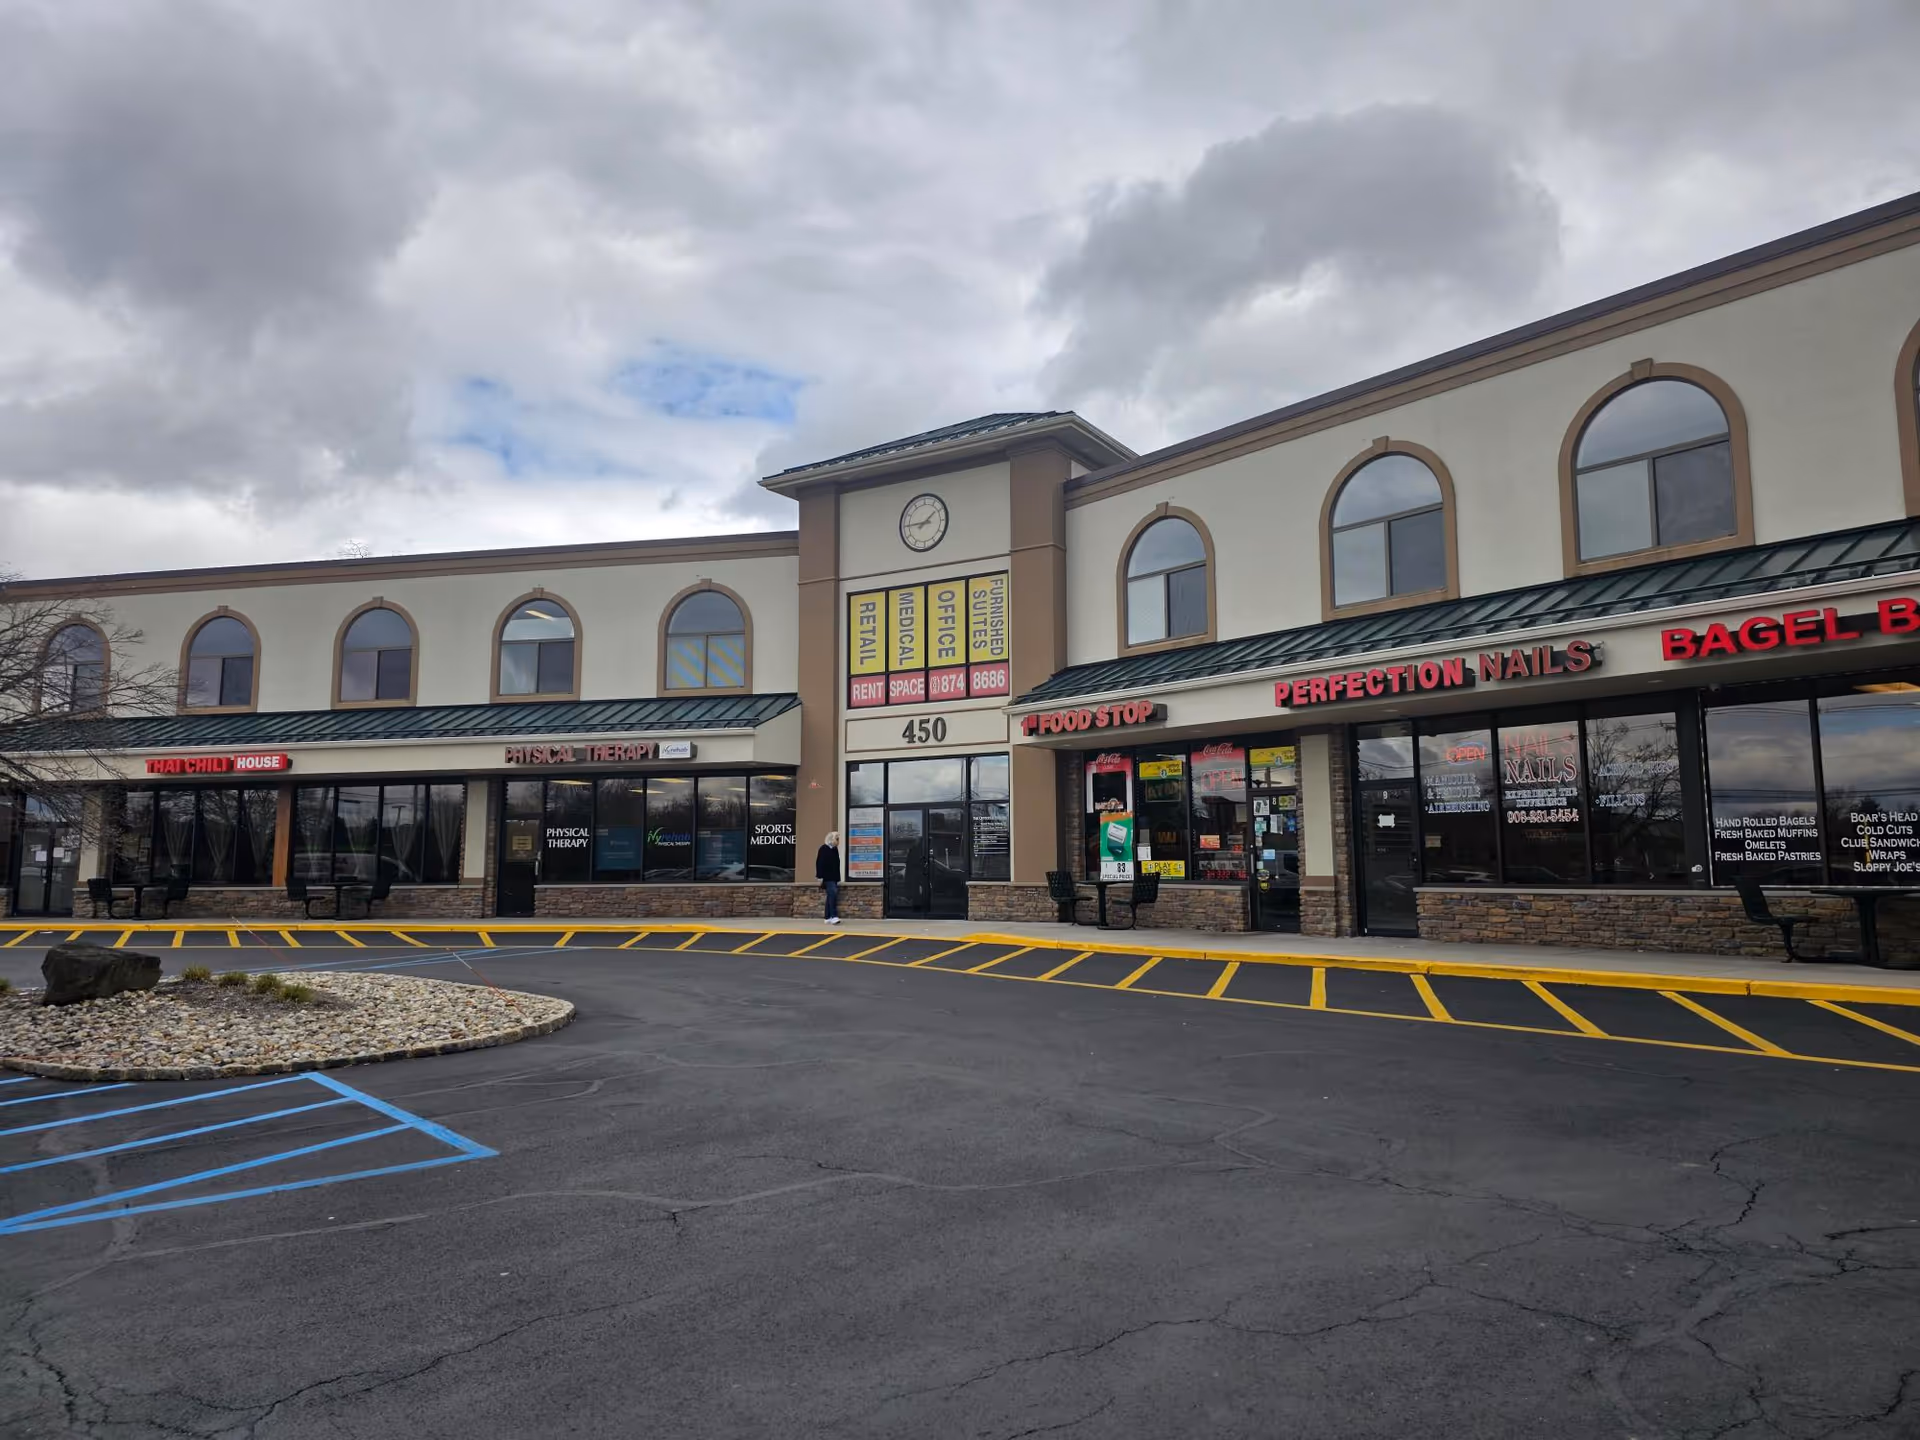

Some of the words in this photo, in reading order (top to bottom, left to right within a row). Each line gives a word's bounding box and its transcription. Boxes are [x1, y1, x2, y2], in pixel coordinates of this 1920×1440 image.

[898, 591, 915, 666] MEDICAL
[937, 590, 956, 659] OFFICE
[972, 590, 987, 650] SUITES
[990, 578, 1004, 656] FURNISHED
[860, 601, 876, 665] RETAIL
[1661, 607, 1860, 661] BAGEL
[852, 682, 884, 700] RENT
[889, 678, 924, 697] SPACE
[941, 672, 965, 693] 874
[973, 669, 1005, 690] 8686
[1275, 657, 1464, 707] PERFECTION
[1479, 640, 1592, 682] NAILS
[902, 717, 947, 744] 450
[1039, 709, 1092, 735] FOOD
[1095, 700, 1153, 728] STOP
[145, 759, 182, 774] THAI
[185, 757, 228, 773] CHILI
[236, 756, 280, 769] HOUSE
[505, 746, 575, 764] PHYSICAL
[584, 742, 656, 761] THERAPY
[1446, 747, 1486, 762] OPEN
[1201, 769, 1243, 789] OPEN
[1504, 754, 1577, 784] NAILS
[1505, 789, 1556, 800] EXPERIENCE
[546, 827, 590, 837] PHYSICAL
[547, 838, 588, 848] THERAPY
[750, 835, 796, 845] MEDICINE
[755, 824, 792, 834] SPORTS
